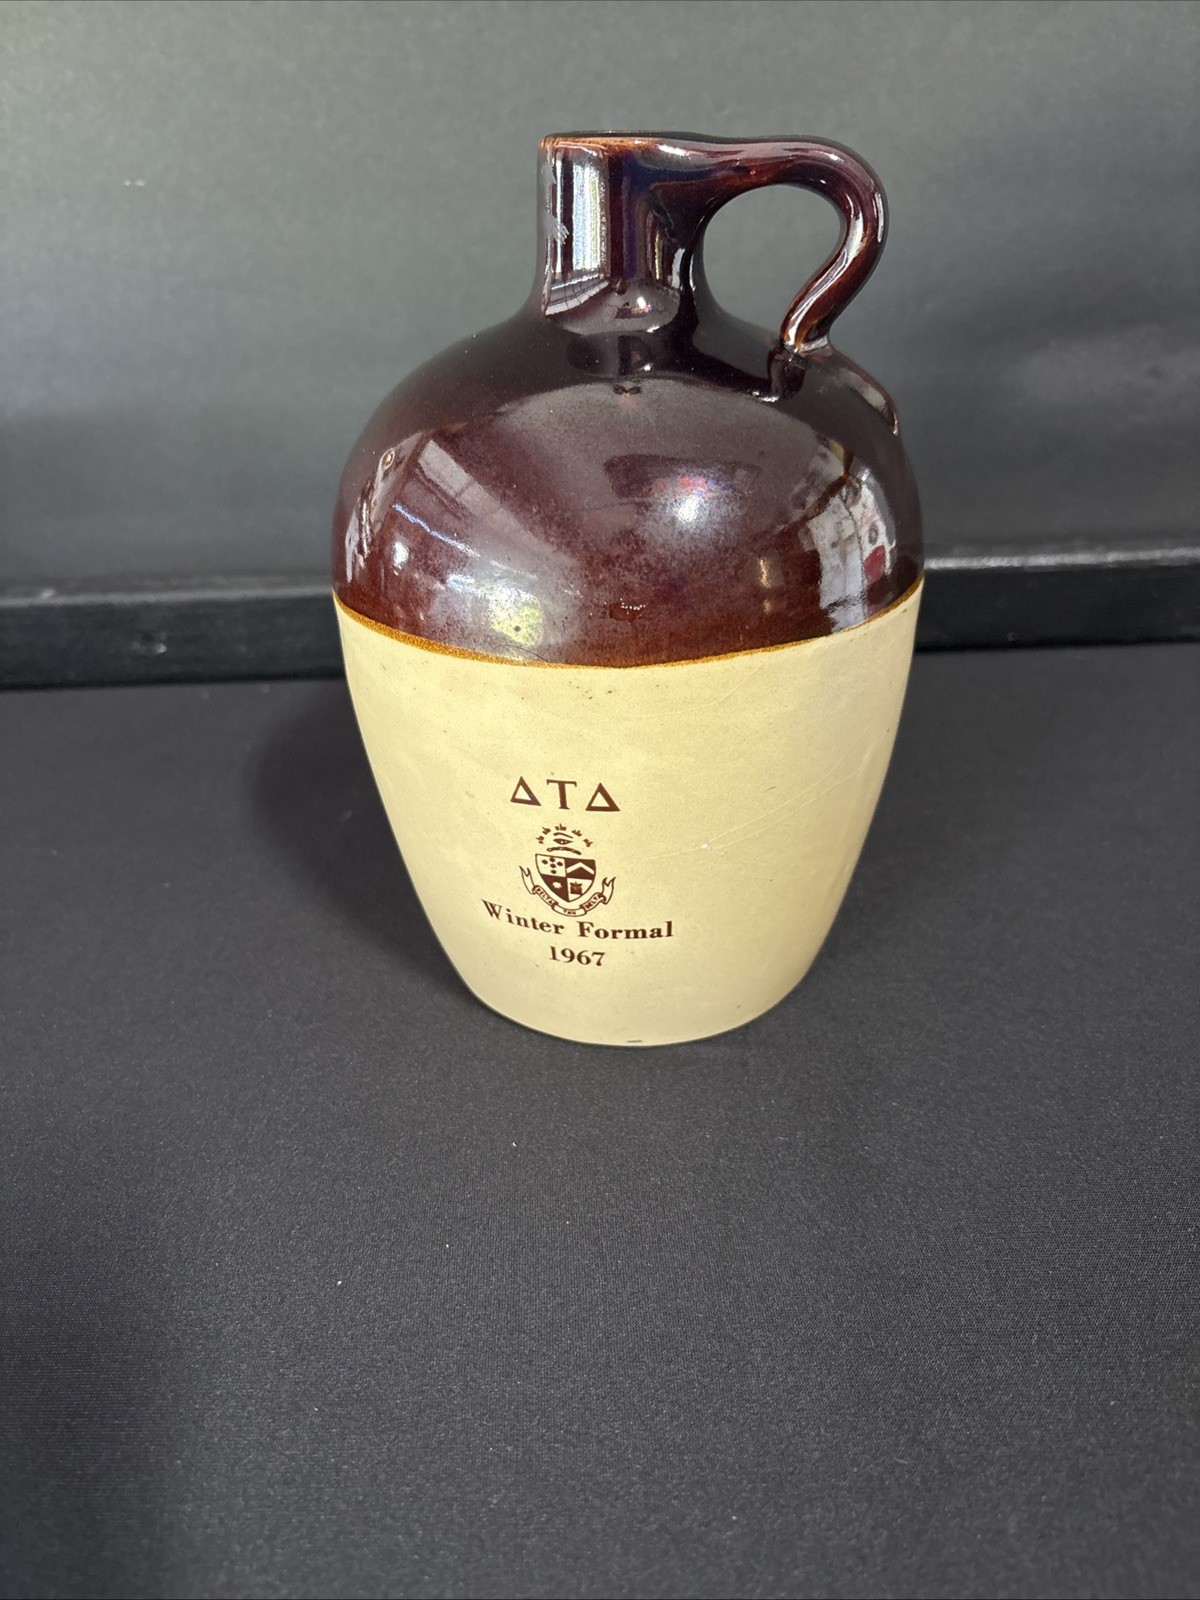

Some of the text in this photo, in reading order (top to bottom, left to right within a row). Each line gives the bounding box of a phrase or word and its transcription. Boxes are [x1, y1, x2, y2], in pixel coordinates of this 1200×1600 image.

[482, 899, 674, 940] Winter Formal
[549, 945, 606, 967] 1967
